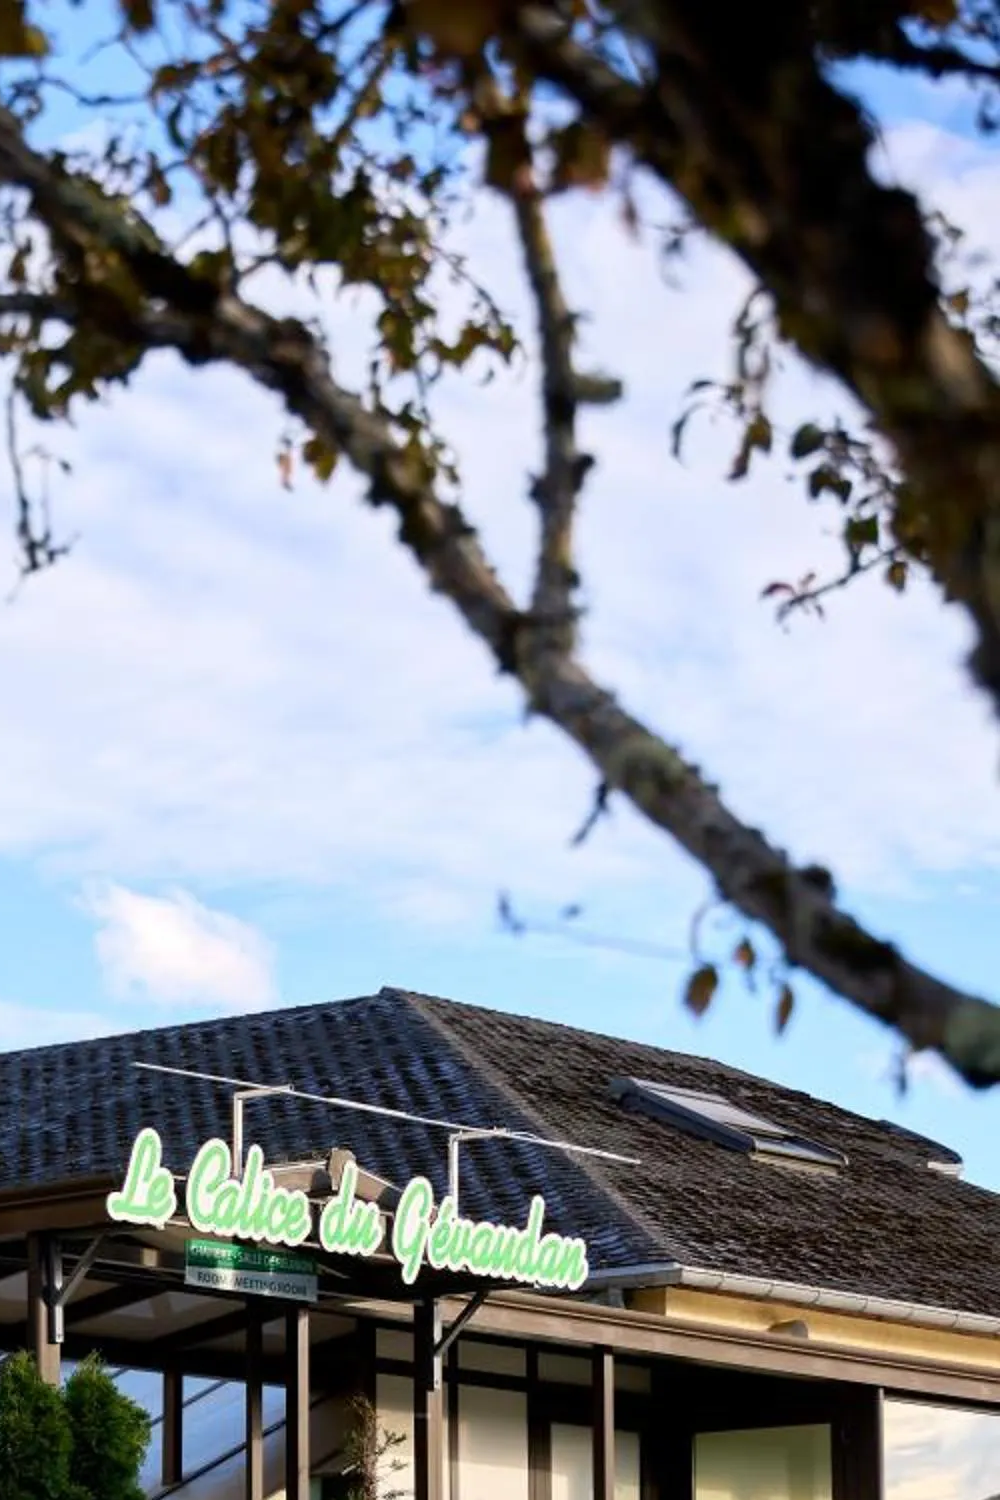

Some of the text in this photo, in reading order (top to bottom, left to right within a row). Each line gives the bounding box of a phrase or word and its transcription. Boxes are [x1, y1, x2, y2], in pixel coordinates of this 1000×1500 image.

[107, 1128, 589, 1290] Le Calice du Gévaudan
